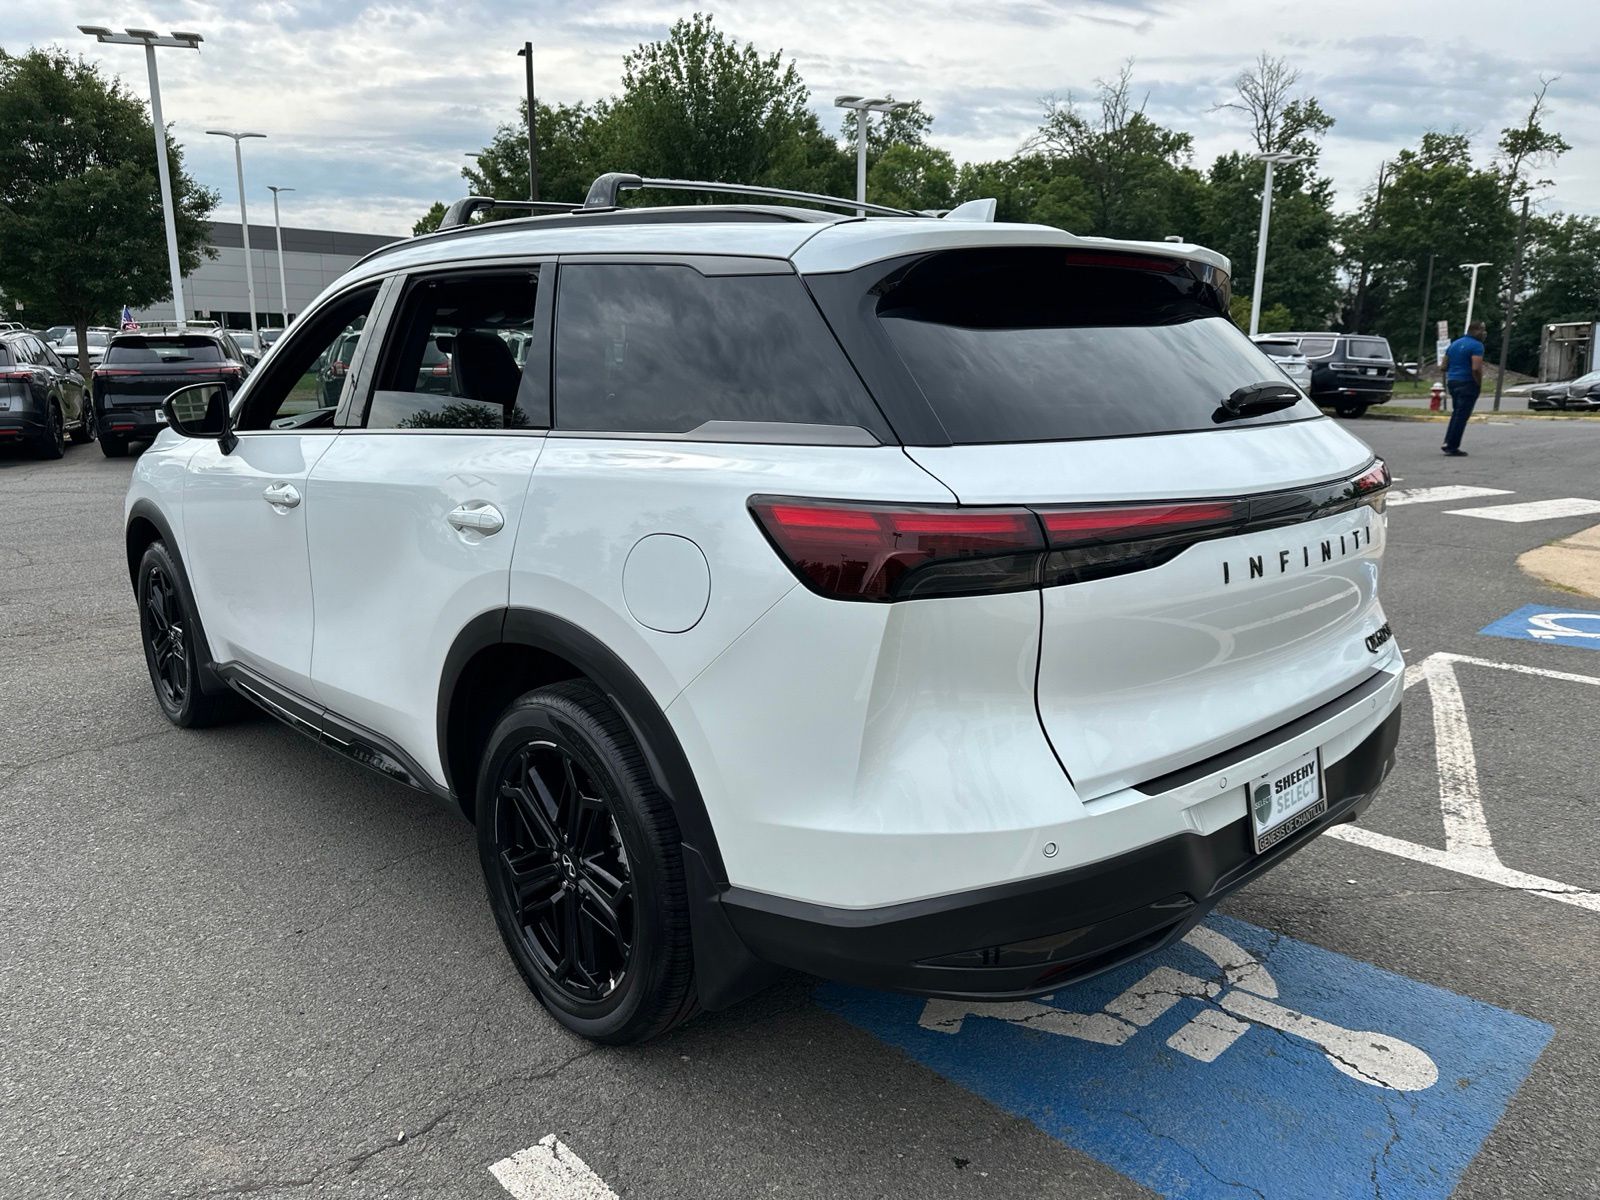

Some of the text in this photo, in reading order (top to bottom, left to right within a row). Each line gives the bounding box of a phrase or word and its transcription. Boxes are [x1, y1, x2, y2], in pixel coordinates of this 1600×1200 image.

[1222, 526, 1370, 584] INFINITI
[1274, 761, 1315, 794] SHEEHY
[1276, 777, 1316, 814] SELECT
[1259, 802, 1325, 850] GENESIS OF CHANTILLY
